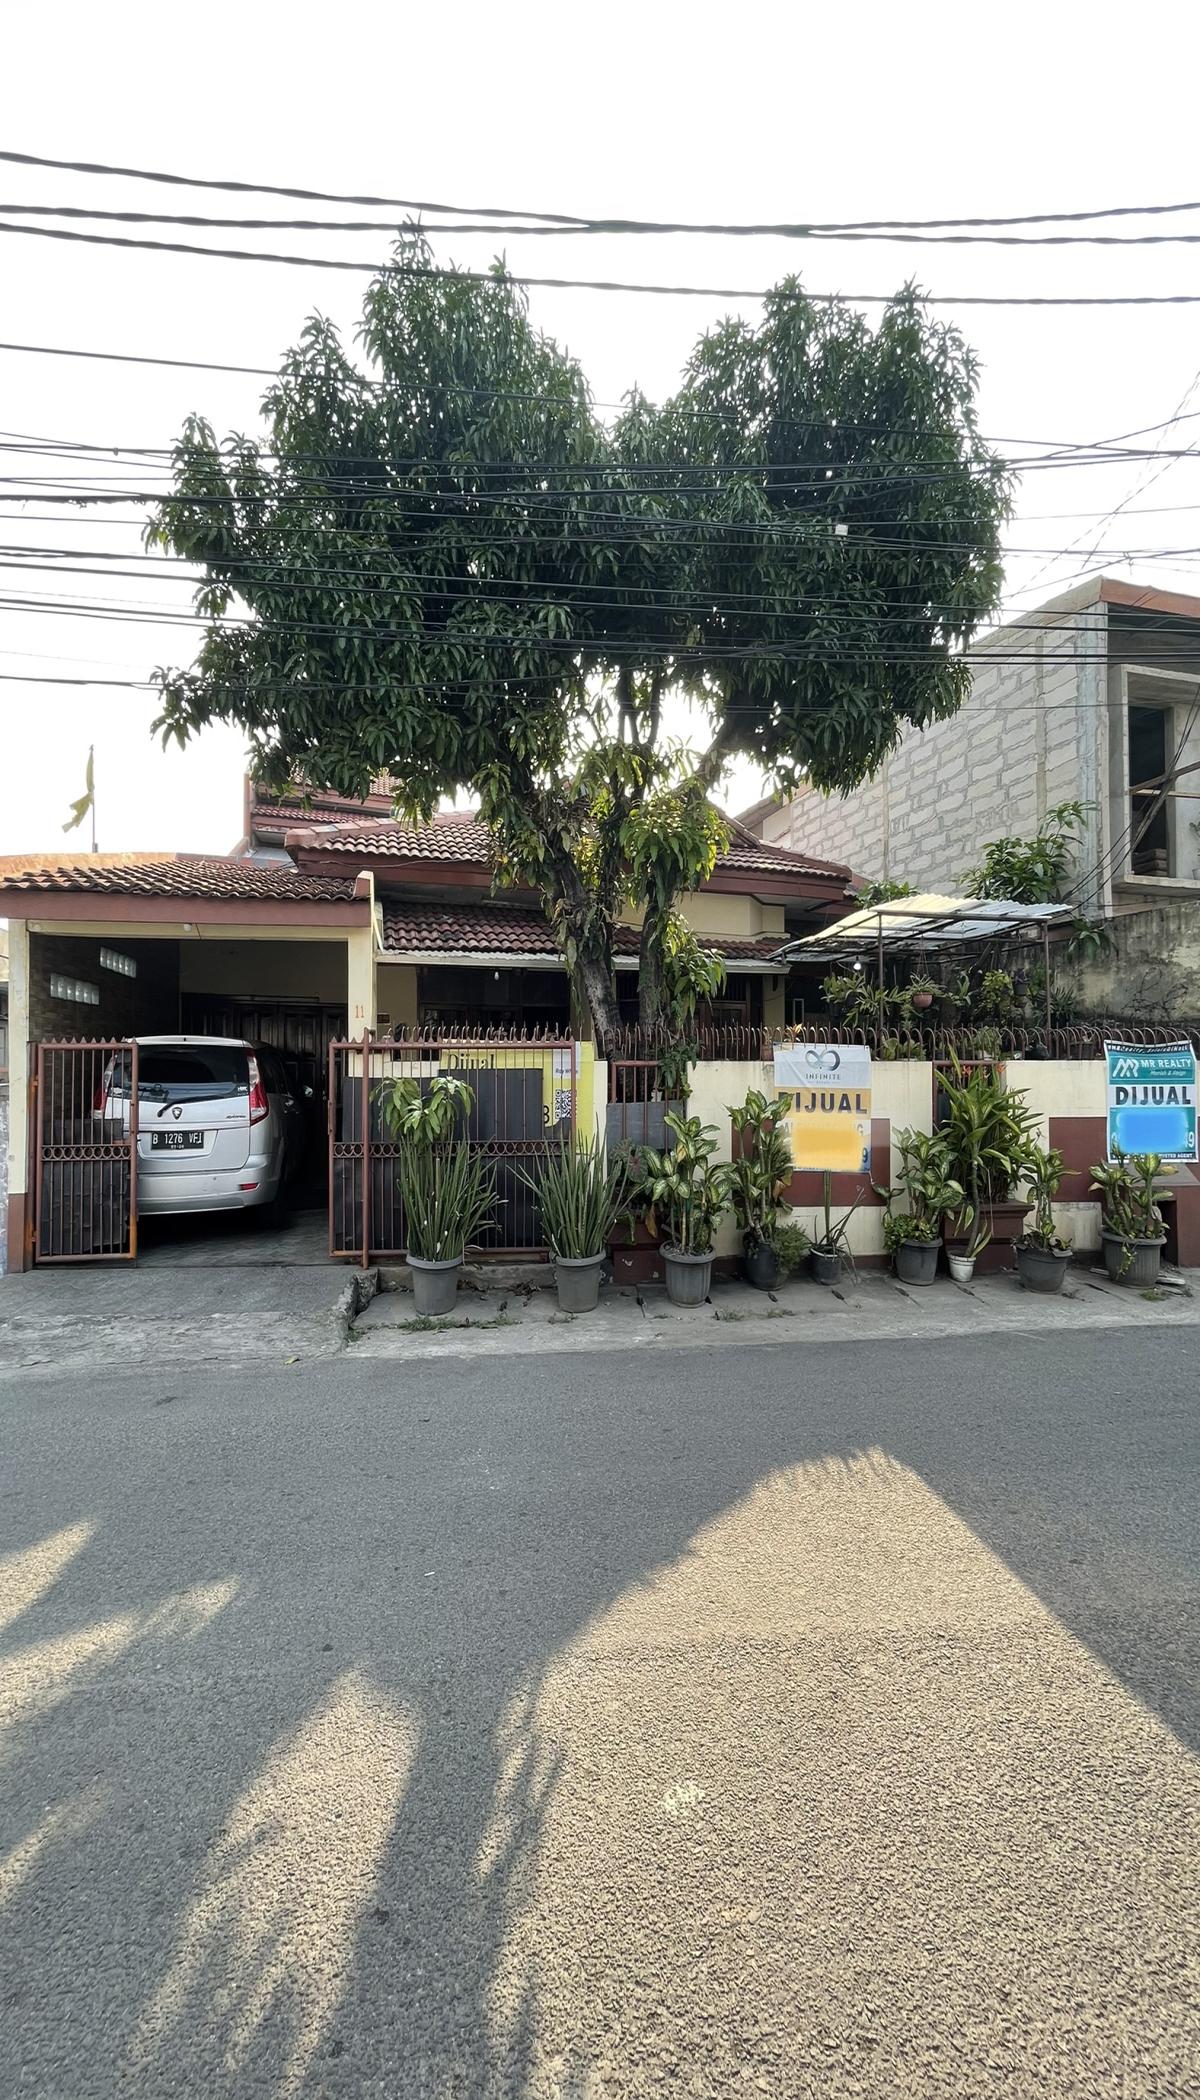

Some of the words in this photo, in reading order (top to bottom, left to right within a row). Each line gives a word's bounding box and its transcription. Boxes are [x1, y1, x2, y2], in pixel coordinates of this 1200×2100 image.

[355, 1004, 364, 1018] 11
[1141, 1059, 1156, 1068] MR
[1158, 1058, 1191, 1067] REALTY
[1115, 1086, 1191, 1106] DIJUAL
[152, 1133, 159, 1144] B
[164, 1133, 183, 1144] 1276
